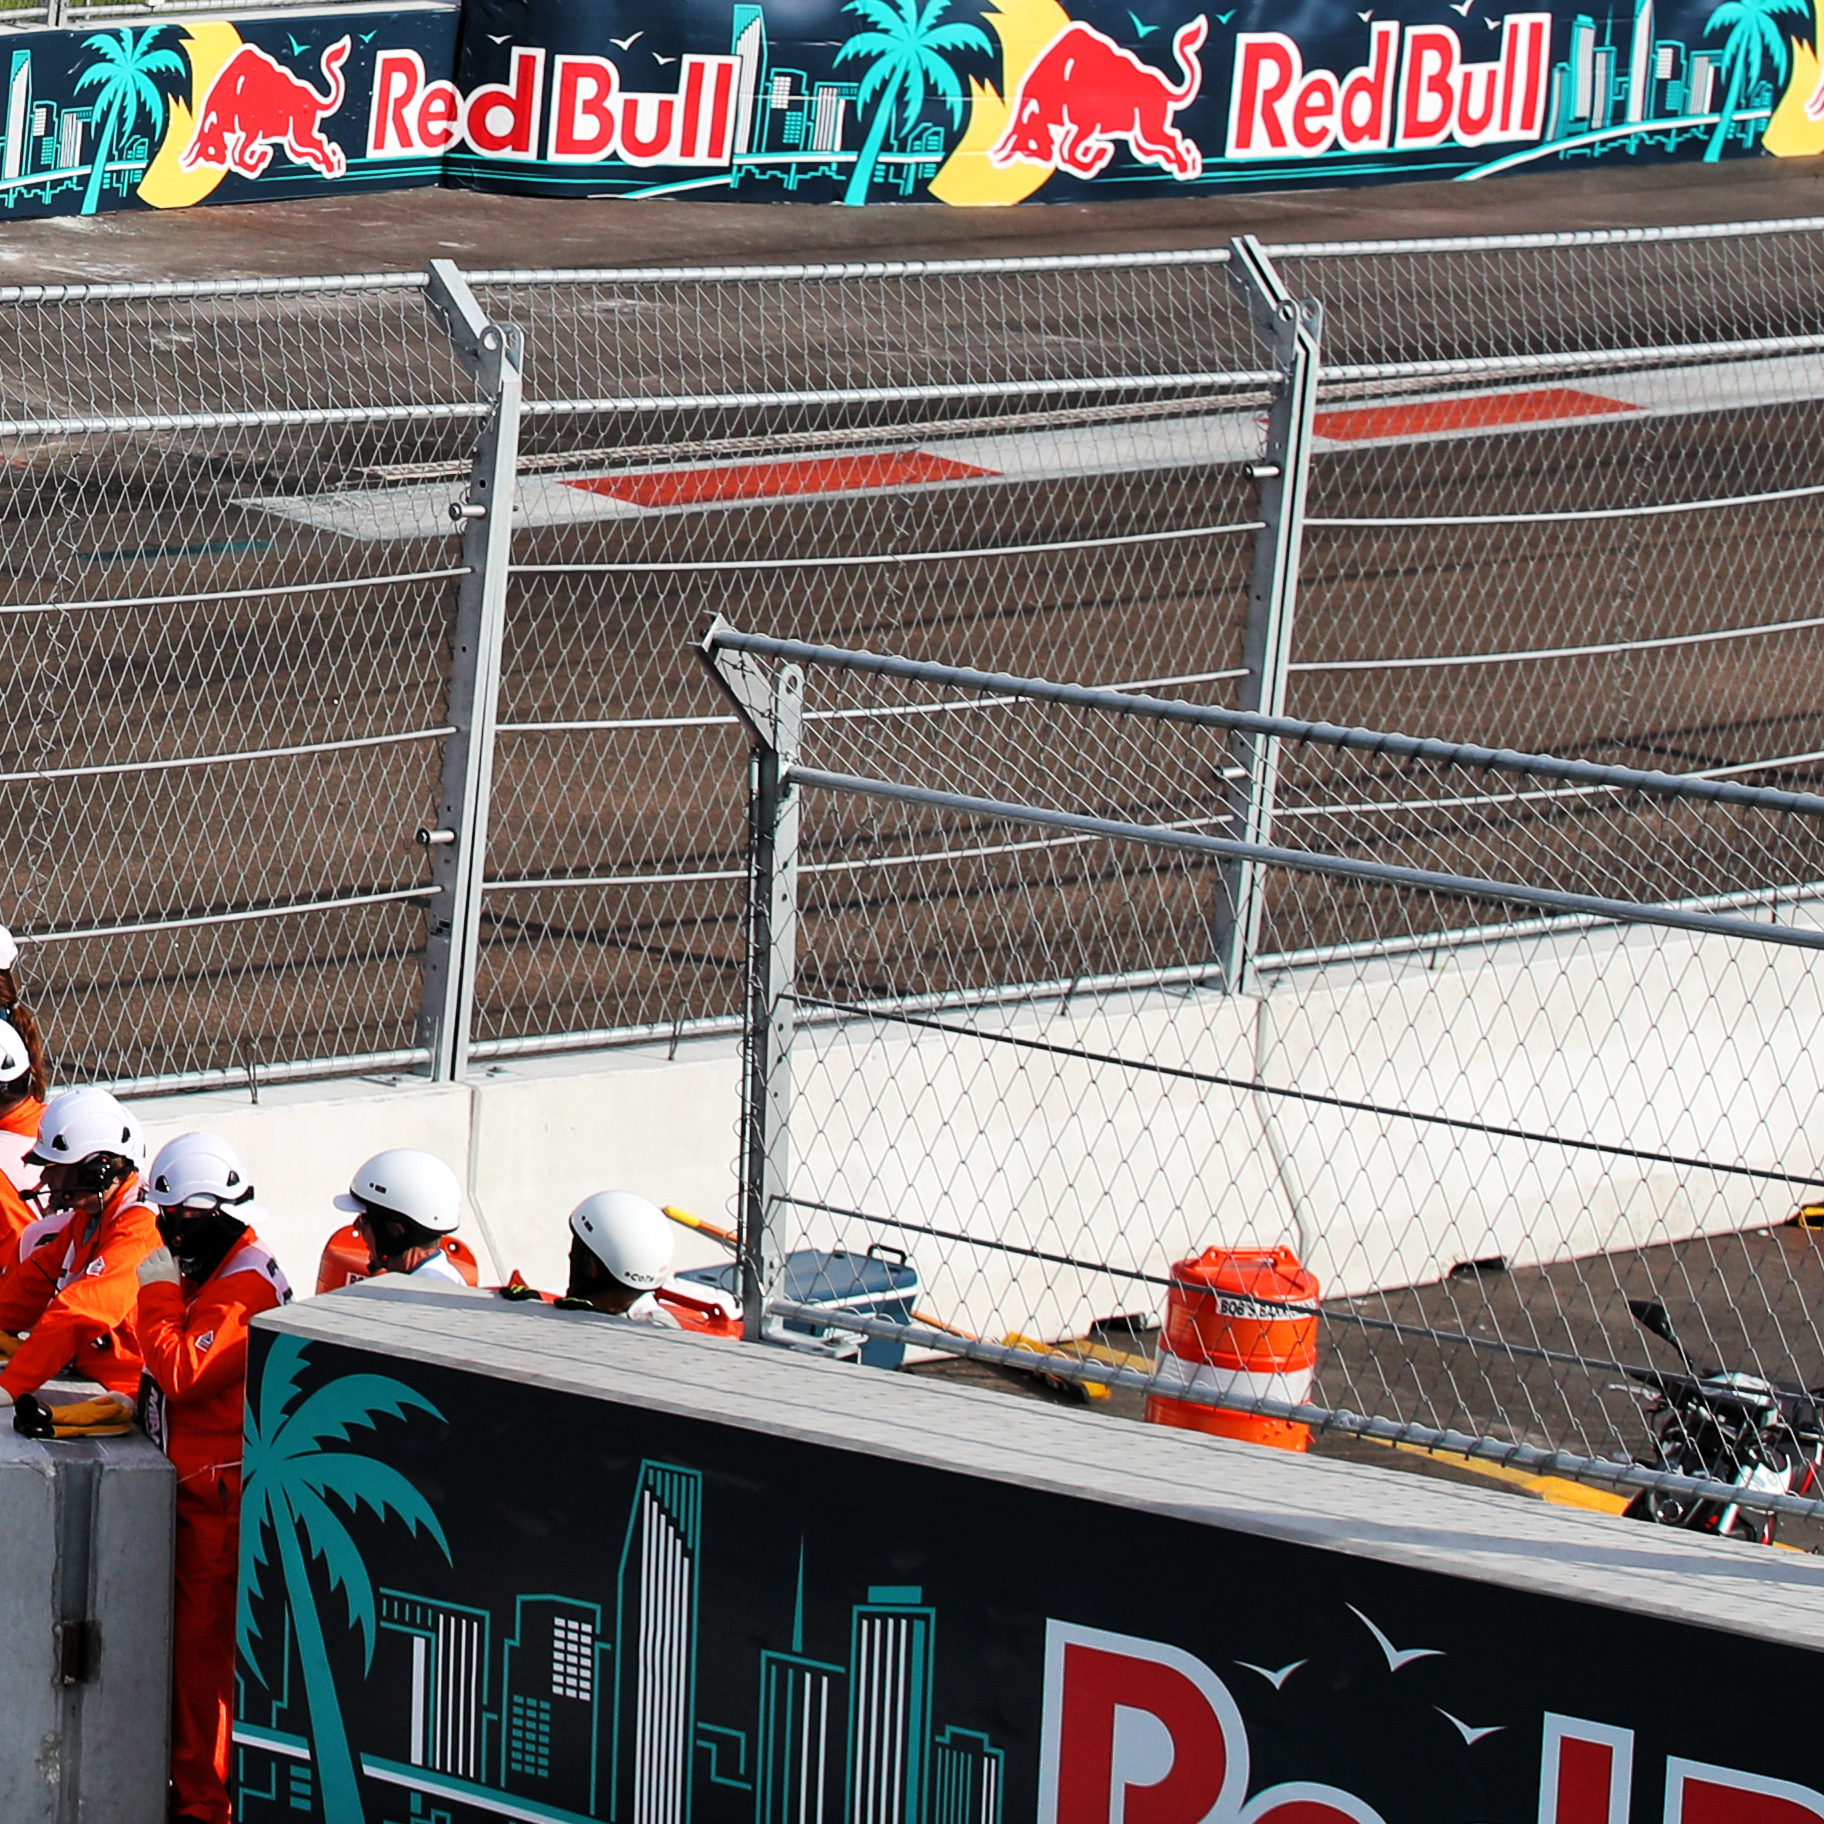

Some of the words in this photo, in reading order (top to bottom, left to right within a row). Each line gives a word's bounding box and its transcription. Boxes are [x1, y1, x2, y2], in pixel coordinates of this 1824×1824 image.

[368, 45, 547, 157] Red
[549, 53, 743, 167] Bull
[1226, 20, 1399, 158] Red
[1396, 12, 1552, 147] Bull
